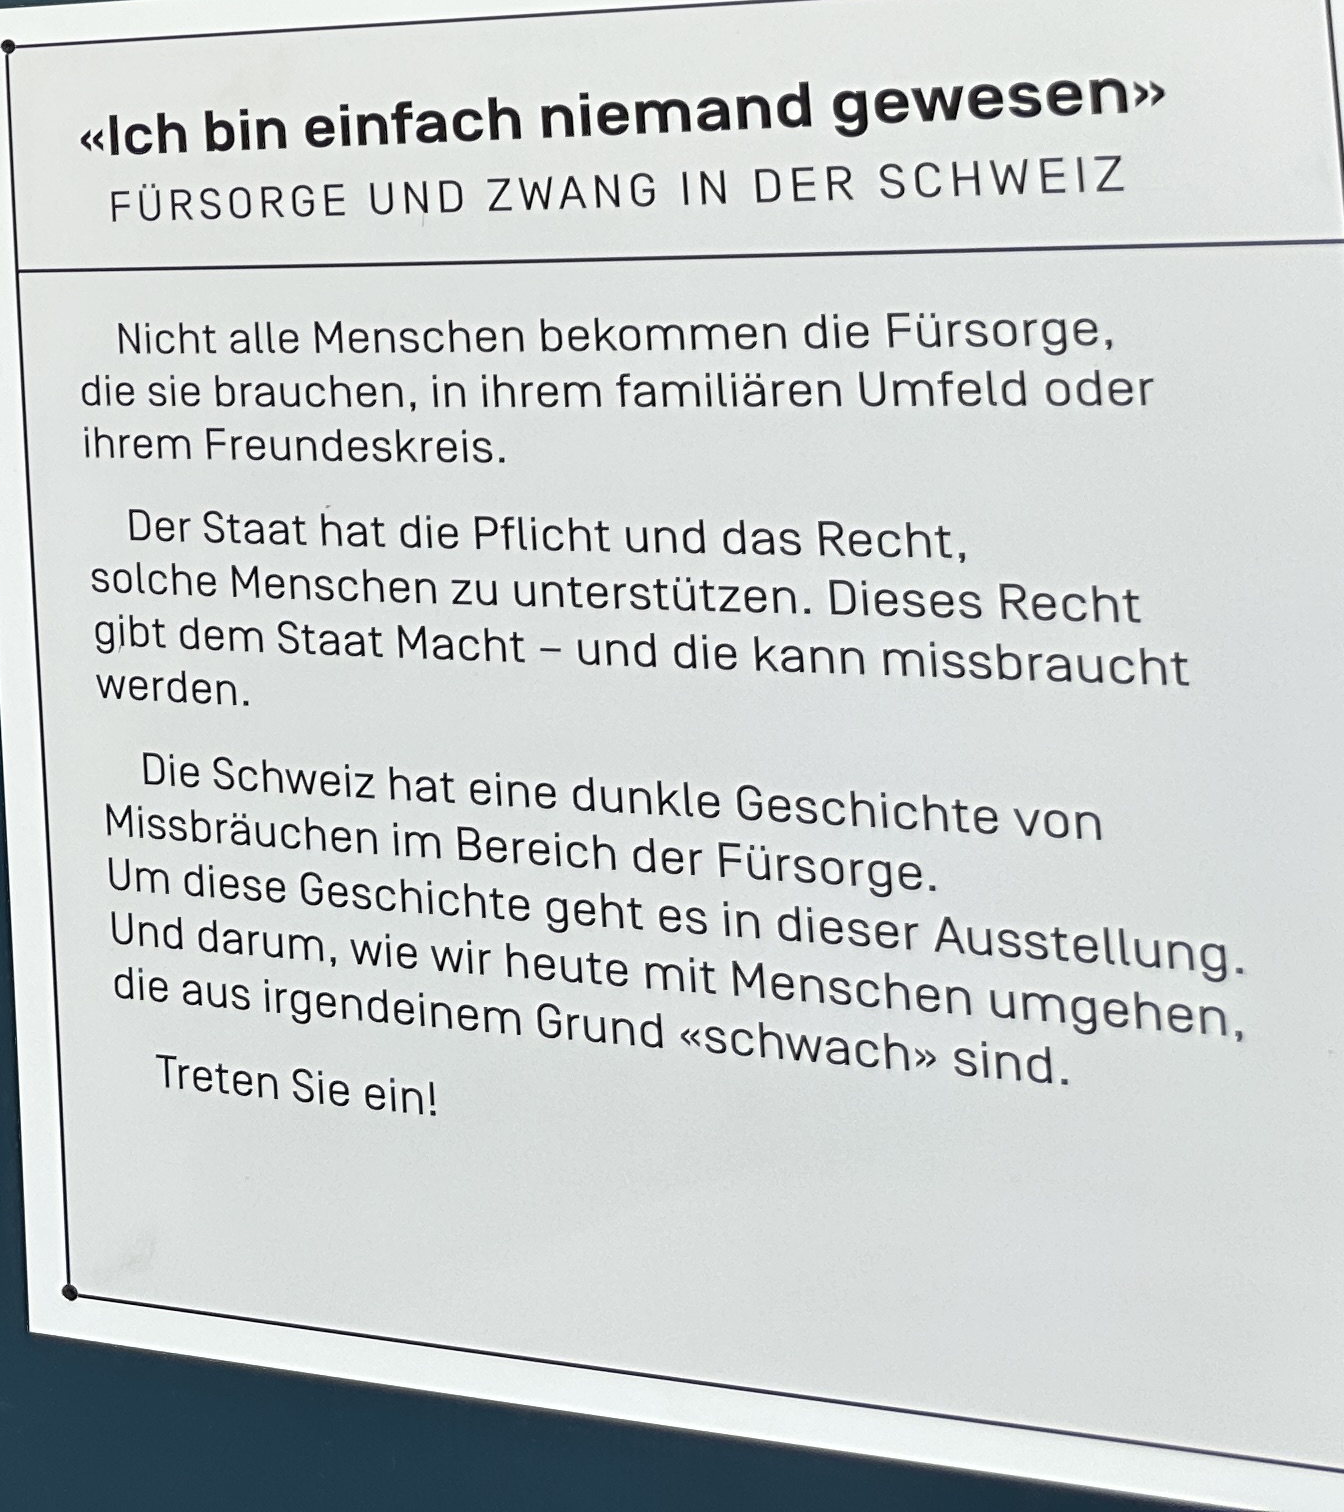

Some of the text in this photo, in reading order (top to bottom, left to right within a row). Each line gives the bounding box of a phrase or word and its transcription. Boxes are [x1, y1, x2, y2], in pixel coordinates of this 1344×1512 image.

[79, 76, 1168, 157] «Ich bin einfach niemand gewesen»
[109, 153, 1126, 224] FÜRSORGE UND ZWANG IN DER SCHWEIZ
[116, 311, 1114, 358] Nicht alle Menschen bekommen die Fürsorge,
[80, 368, 1156, 414] die sie brauchen, in ihrem familiären Umfeld oder
[82, 424, 507, 465] ihrem Freundeskreis.
[127, 507, 967, 565] Der Staat hat die Pflicht und das Recht,
[90, 560, 1143, 625] solche Menschen zu unterstützen. Dieses Recht
[93, 612, 168, 656] gibt
[178, 615, 265, 654] dem
[276, 619, 385, 659] Staat
[396, 623, 527, 665] Macht
[576, 631, 658, 669] und
[672, 632, 739, 672] die
[752, 634, 867, 677] kann
[881, 639, 1191, 688] missbraucht
[94, 668, 251, 708] werden.
[141, 750, 1103, 842] Die Schweiz hat eine dunkle Geschichte von
[104, 801, 938, 900] Missbräuchen im Bereich der Fürsorge.
[107, 855, 1245, 985] Um diese Geschichte geht es in dieser Ausstellung.
[109, 909, 1245, 1049] Und darum, wie wir heute mit Menschen umgehen,
[113, 965, 1070, 1087] die aus irgendeinem Grund «schwach» sind.
[154, 1052, 438, 1118] Treten Sie ein!
